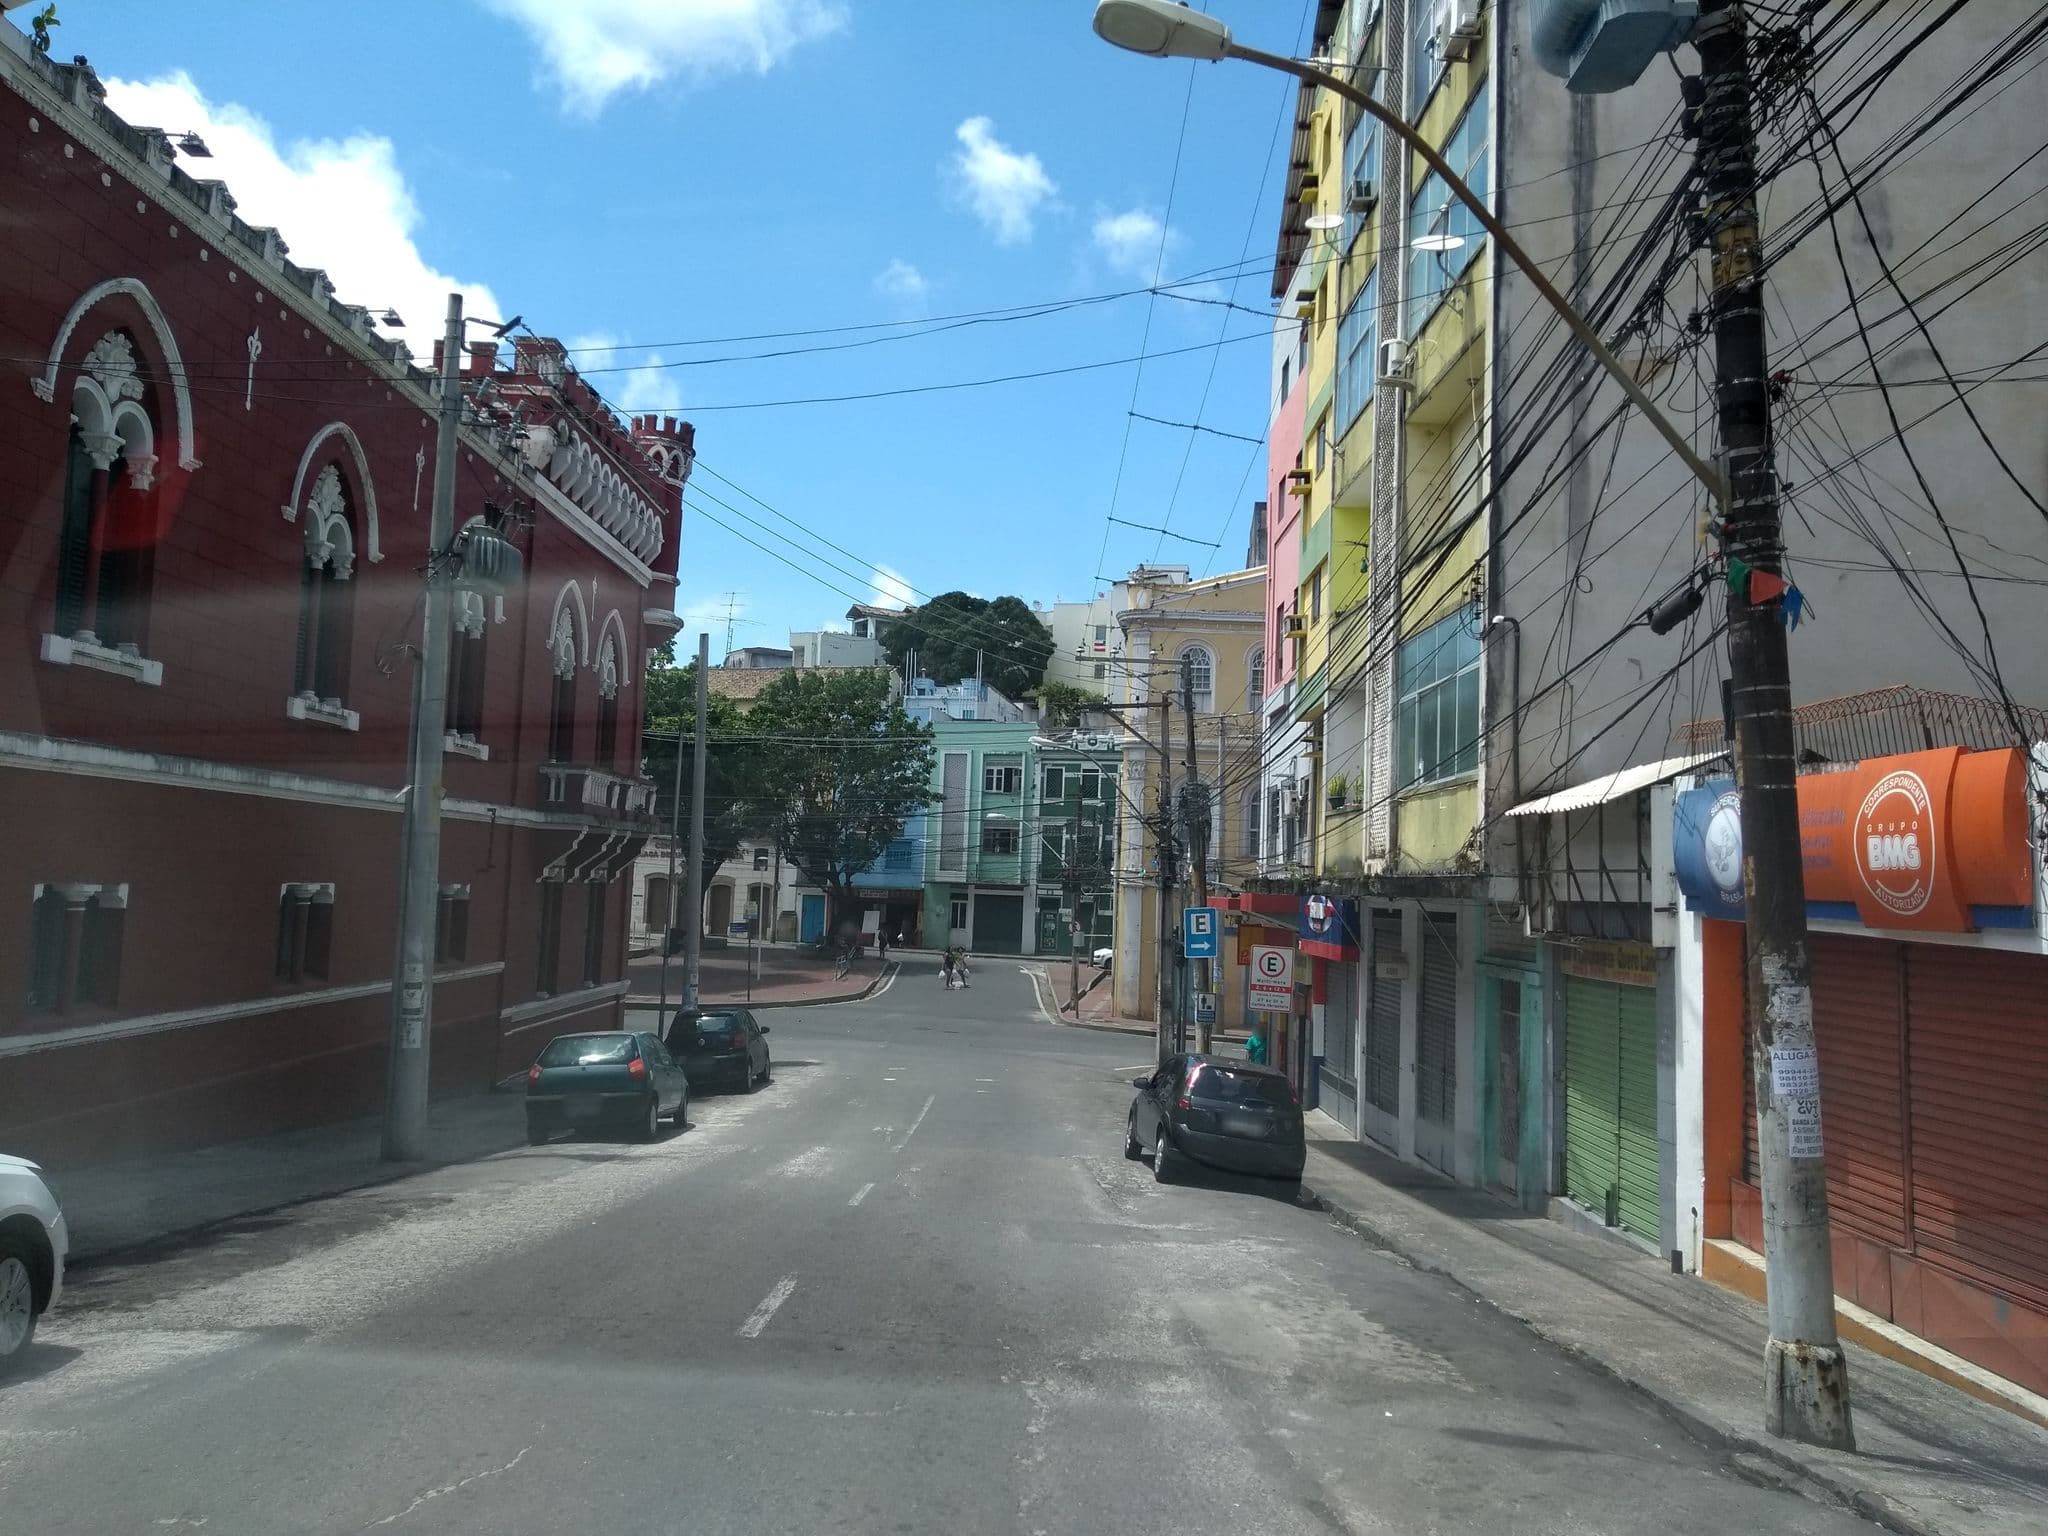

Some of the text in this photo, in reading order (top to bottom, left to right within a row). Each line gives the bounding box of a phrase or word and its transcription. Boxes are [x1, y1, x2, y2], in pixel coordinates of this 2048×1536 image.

[1864, 777, 1926, 813] CORRESPONDENTE
[1866, 821, 1918, 833] GRUPO
[1867, 833, 1922, 870] BMG
[1875, 887, 1925, 910] AUTORIZADO
[1195, 915, 1206, 933] E
[1267, 957, 1277, 972] E
